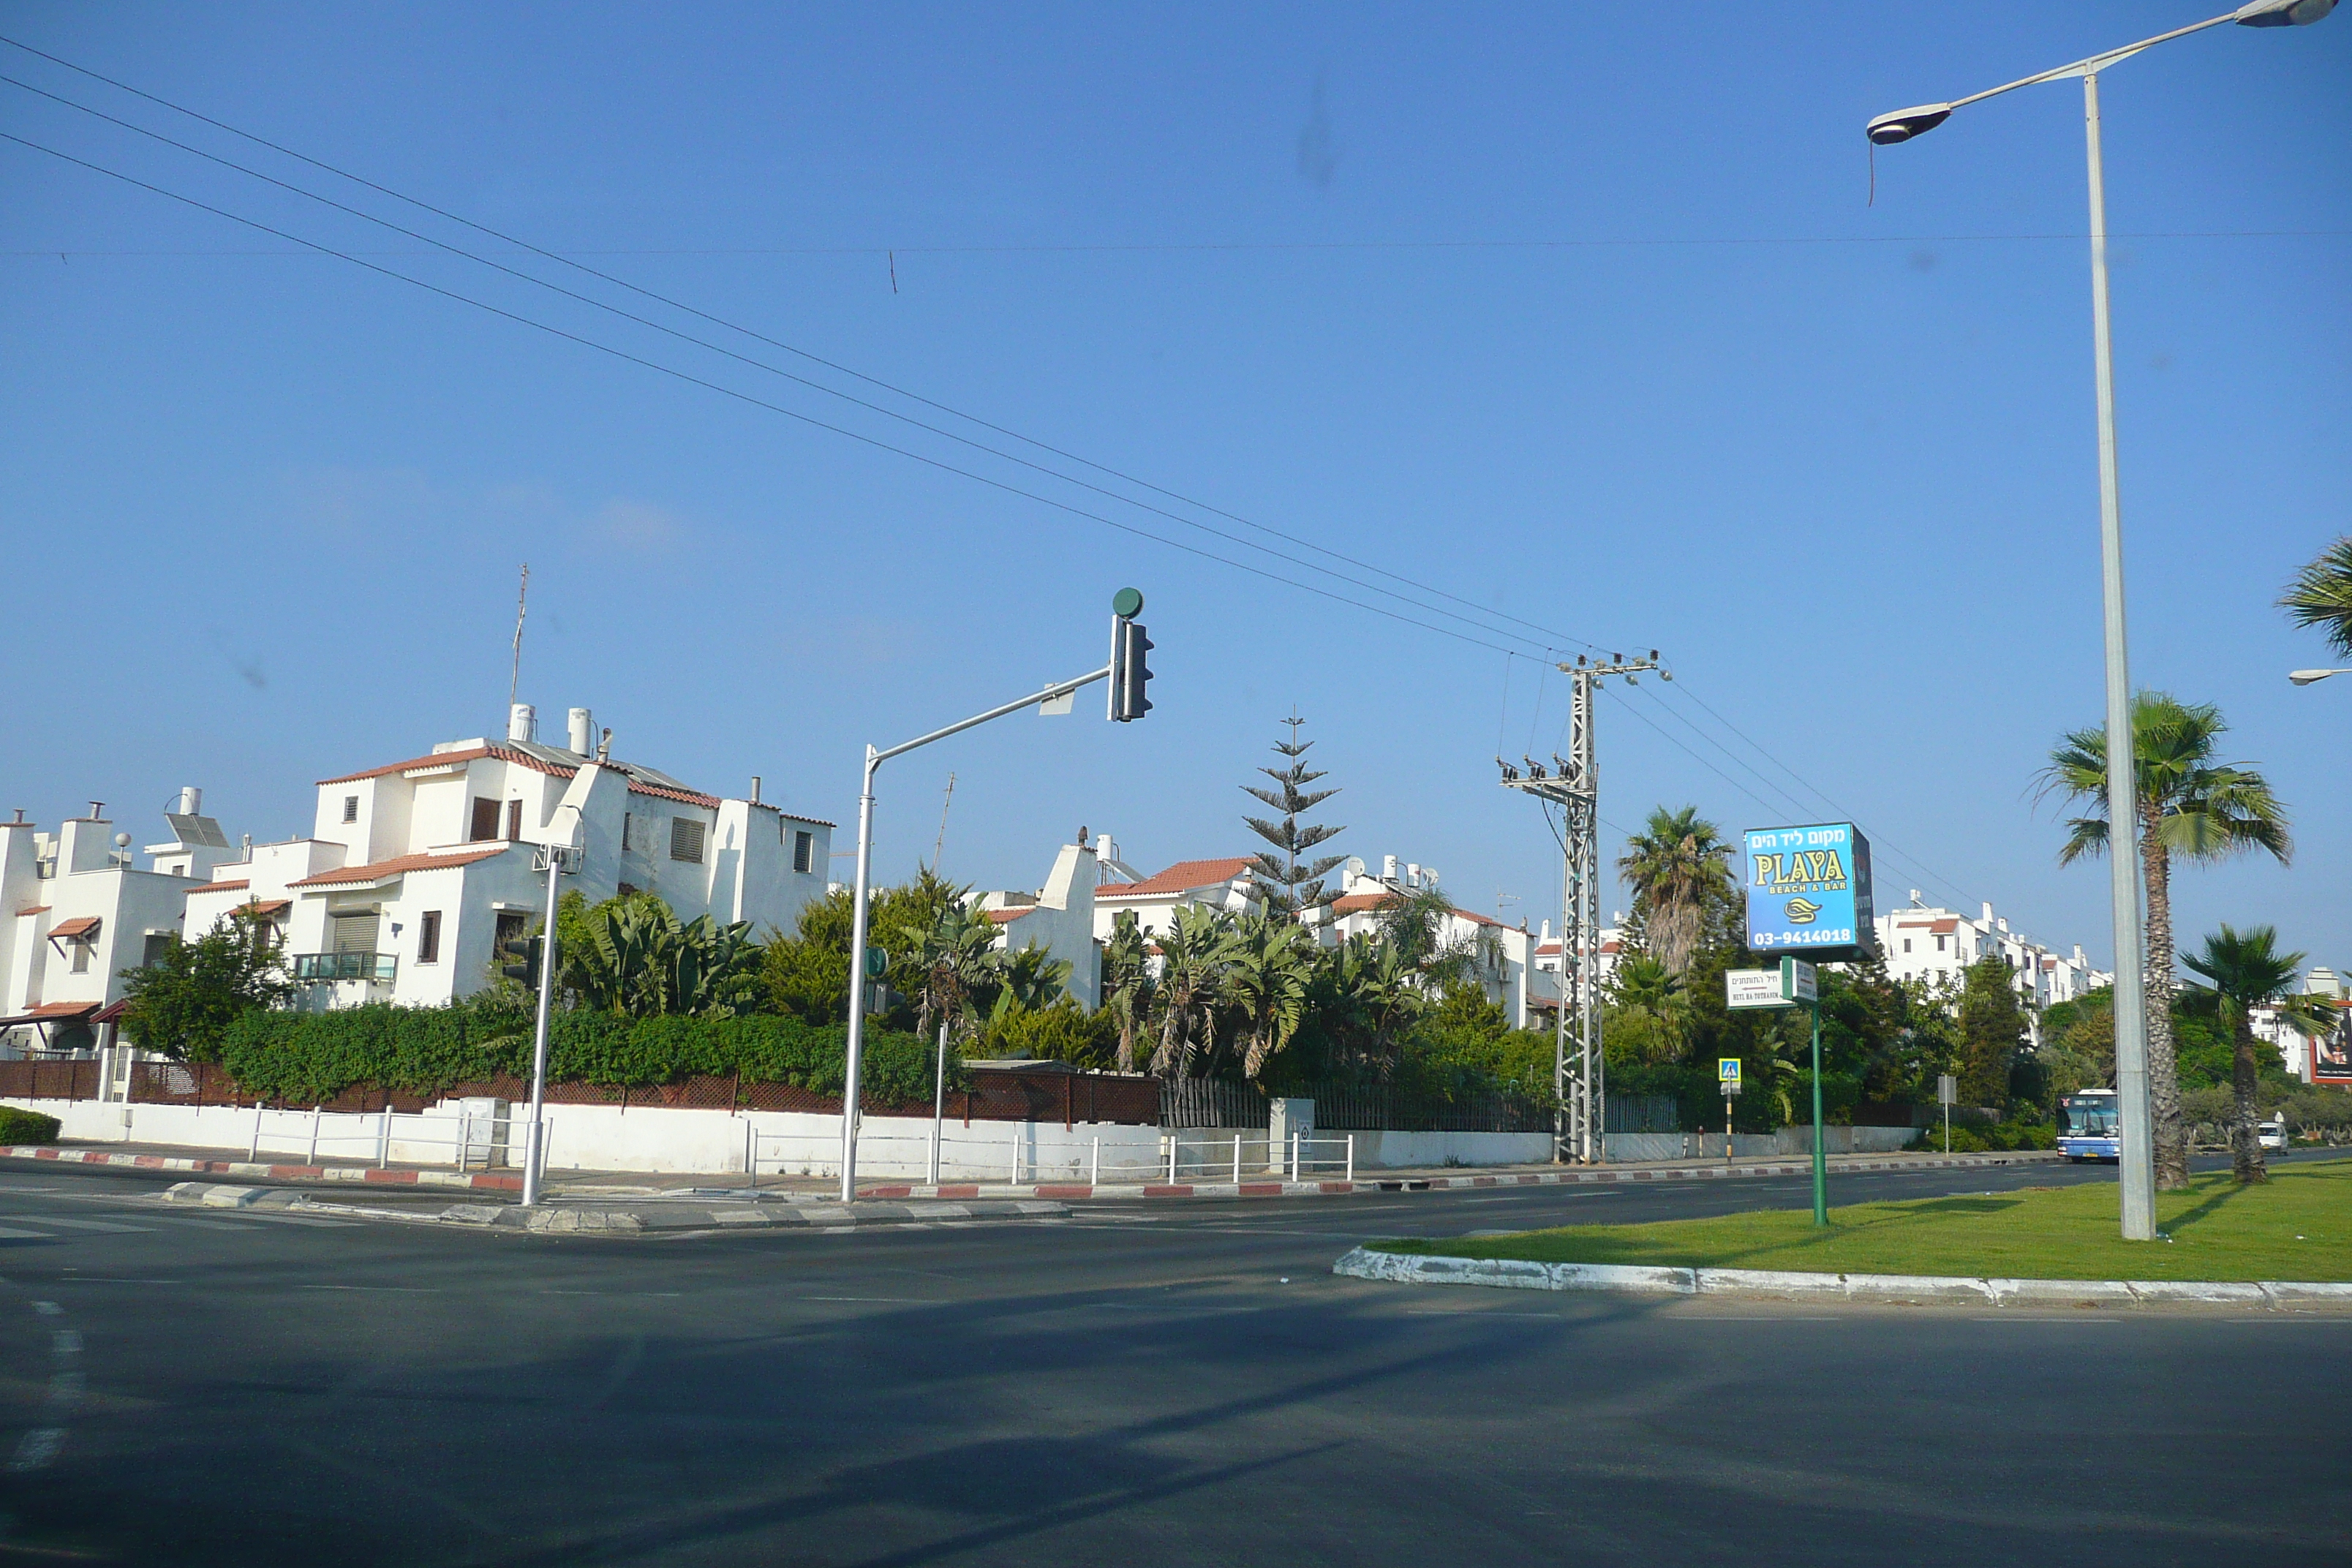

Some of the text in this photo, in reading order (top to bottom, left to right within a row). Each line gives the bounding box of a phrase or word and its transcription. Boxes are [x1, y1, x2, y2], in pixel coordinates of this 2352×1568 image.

[1751, 829, 1845, 848] מקום ליד הים
[1753, 849, 1847, 886] PLAYA
[1769, 881, 1847, 894] BEACH & BAR
[1754, 928, 1851, 946] 03-9414018
[1732, 974, 1778, 985] חיל התותחנים
